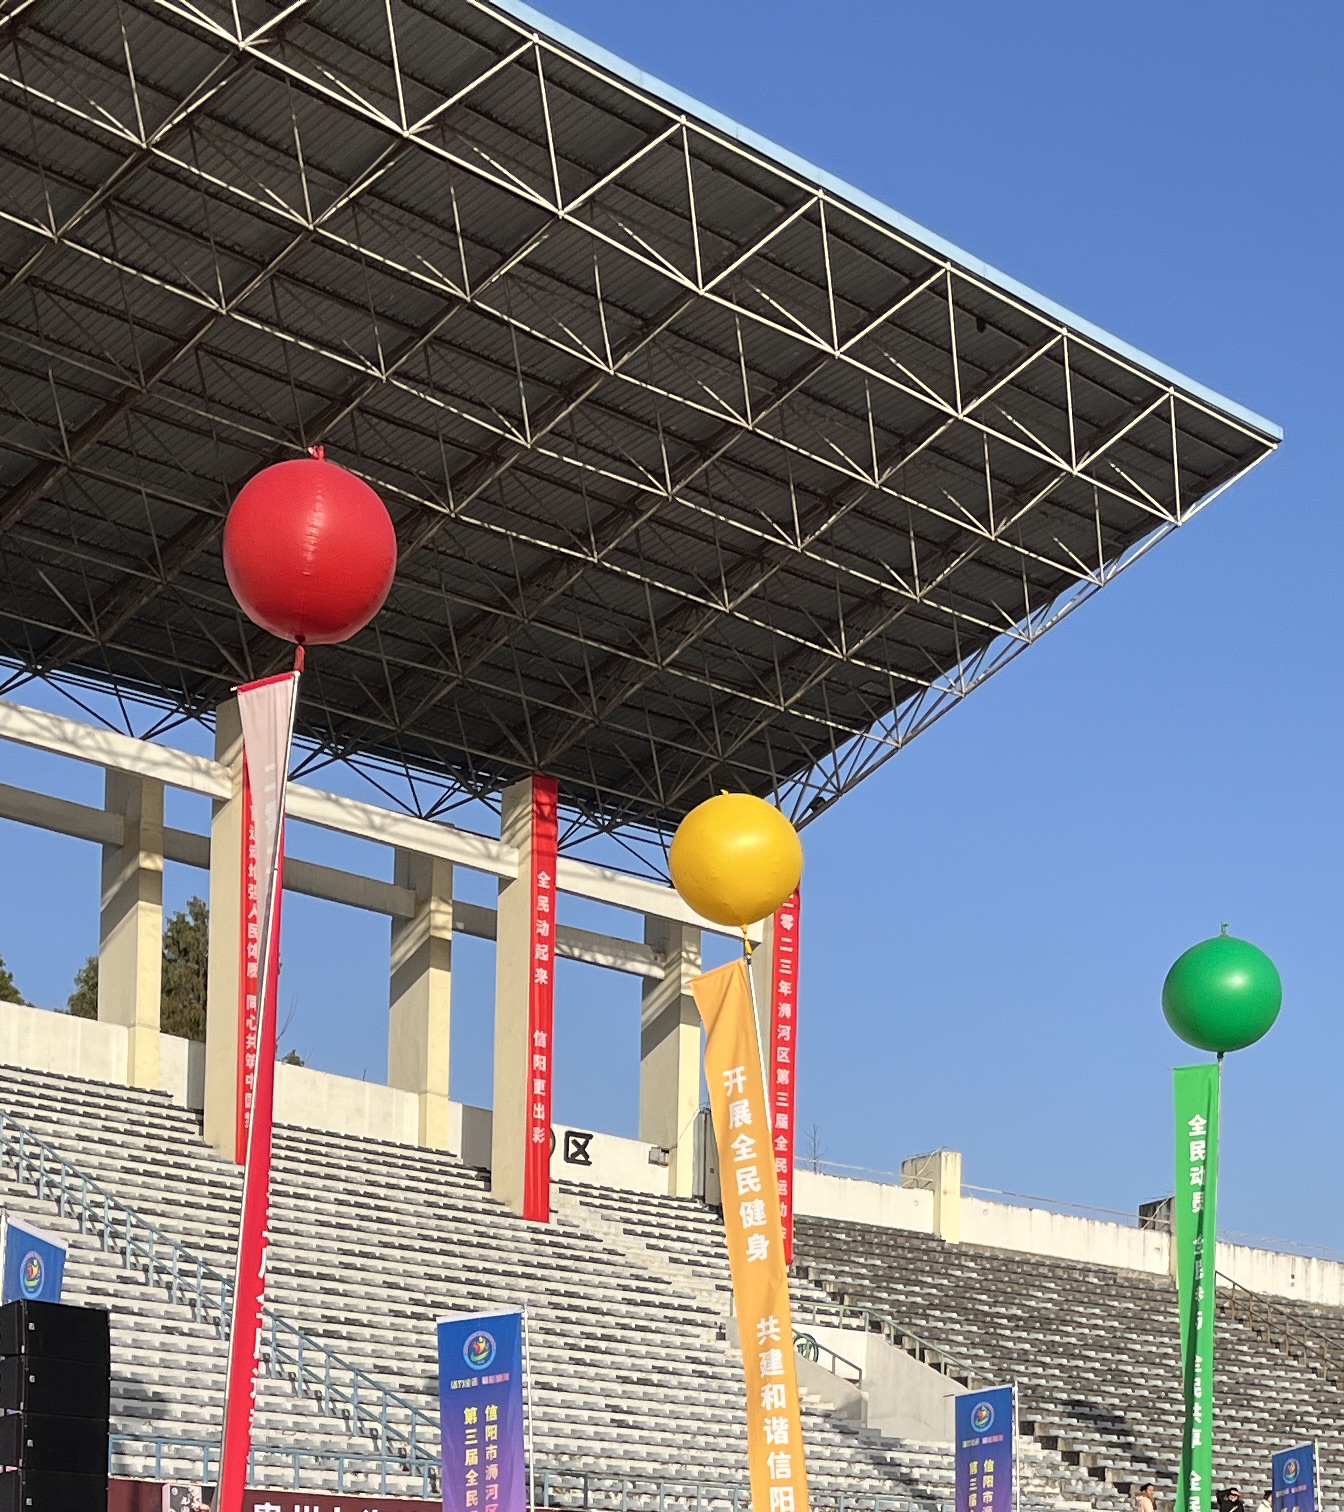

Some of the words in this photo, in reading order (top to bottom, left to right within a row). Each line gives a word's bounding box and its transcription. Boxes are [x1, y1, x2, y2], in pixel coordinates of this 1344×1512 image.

[534, 870, 552, 986] 全民动起来
[532, 1029, 548, 1145] 信阳更出彩
[722, 1065, 770, 1263] 开展全民健身
